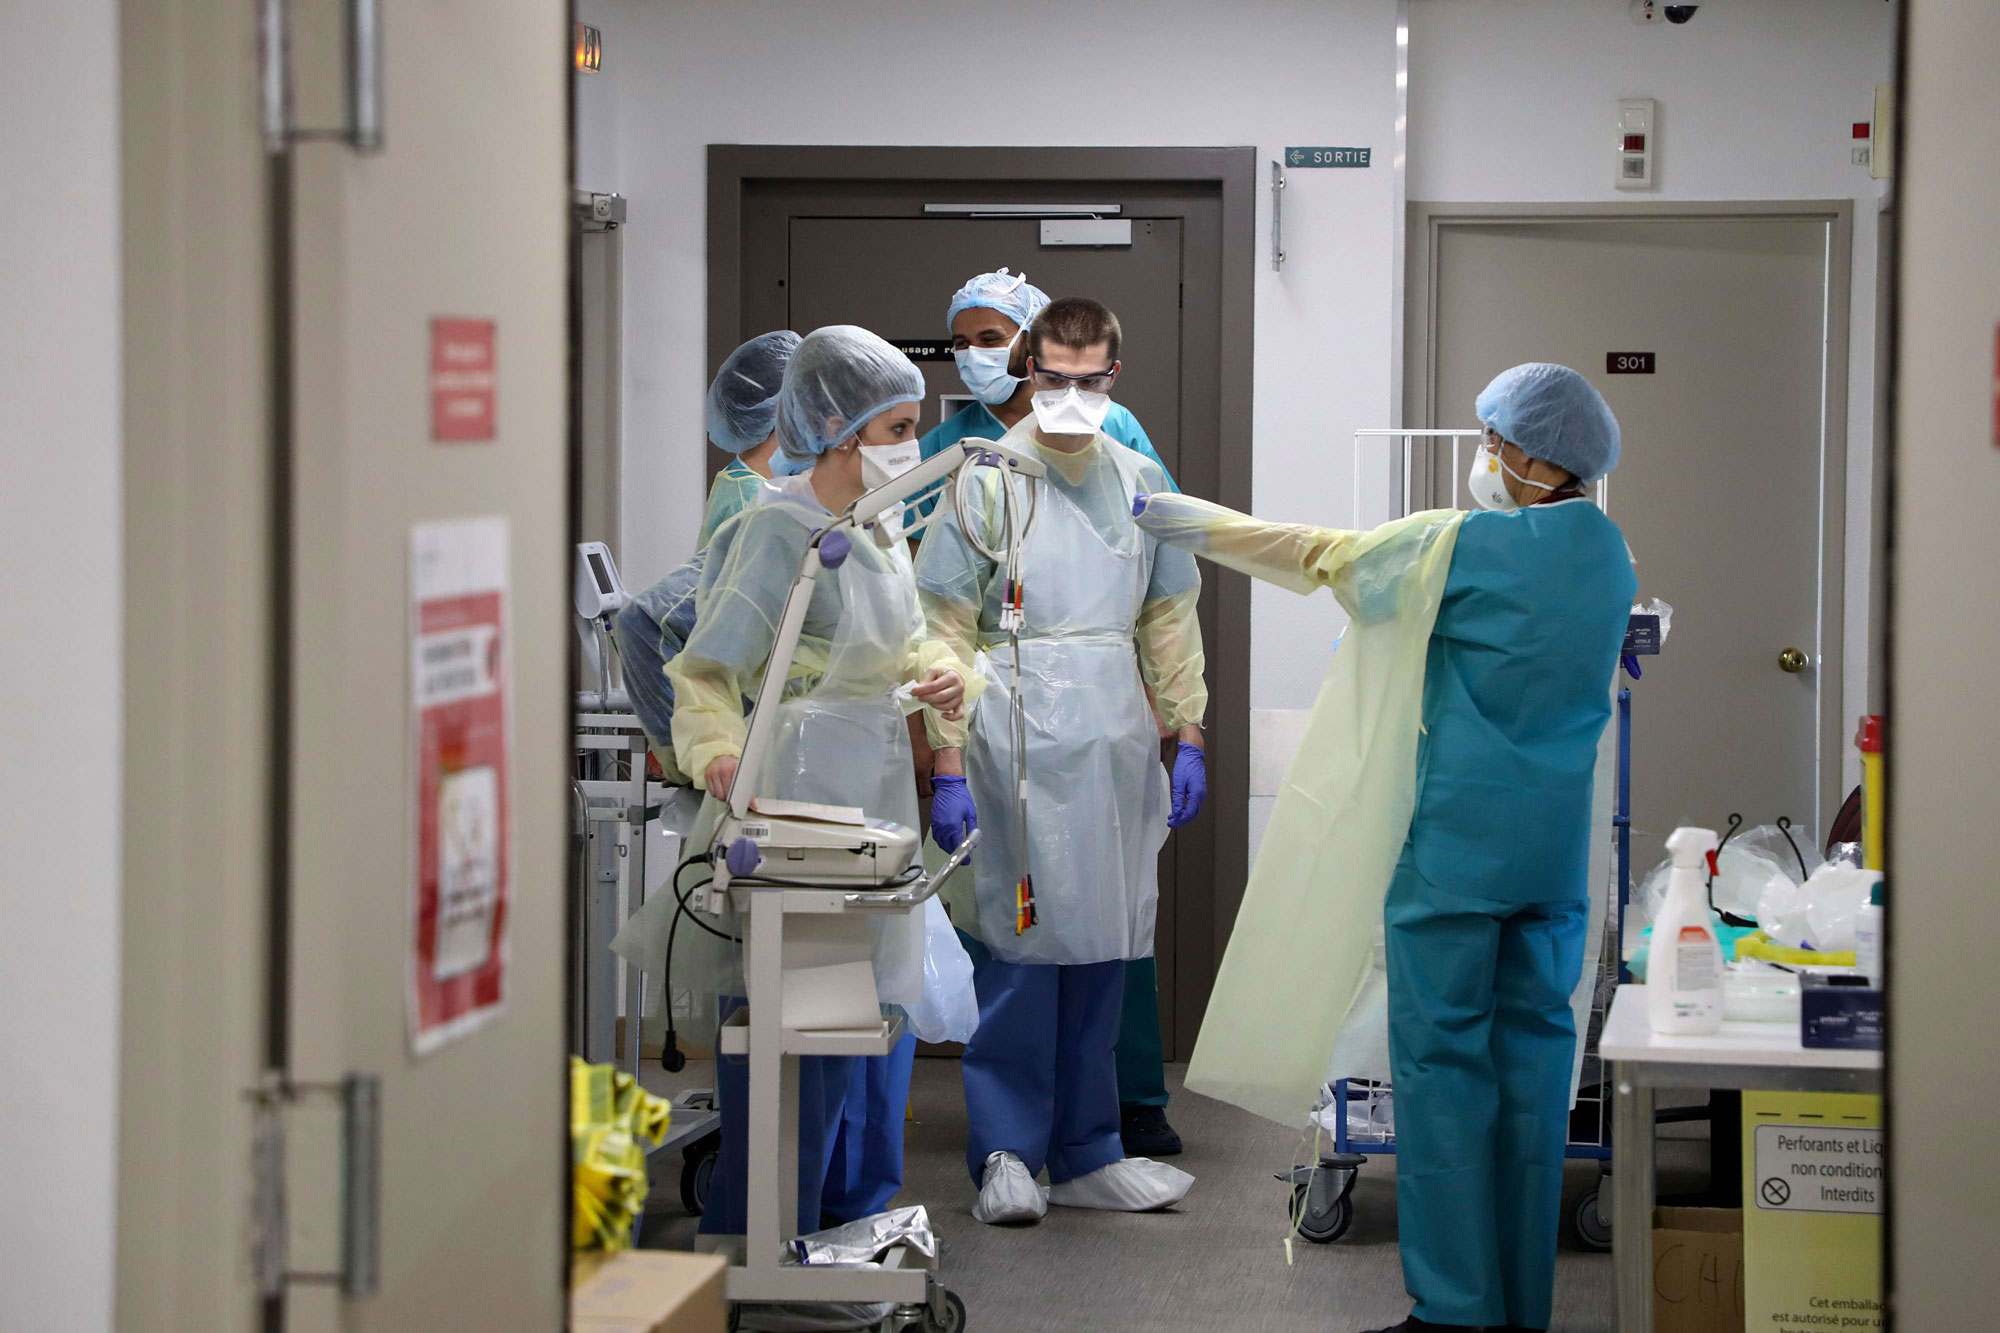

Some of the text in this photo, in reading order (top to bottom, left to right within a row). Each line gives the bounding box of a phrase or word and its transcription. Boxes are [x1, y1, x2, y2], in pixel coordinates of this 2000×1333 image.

[1313, 151, 1368, 163] SORTIE
[901, 347, 936, 356] usage
[1617, 356, 1646, 370] 301
[1777, 1134, 1844, 1153] Perforants
[1846, 1139, 1860, 1154] et
[1791, 1161, 1883, 1178] non condition
[1820, 1185, 1876, 1203] Interdits
[1809, 1296, 1829, 1308] Cet
[1771, 1312, 1790, 1322] est
[1792, 1313, 1839, 1326] autorisé
[1841, 1316, 1870, 1328] pour
